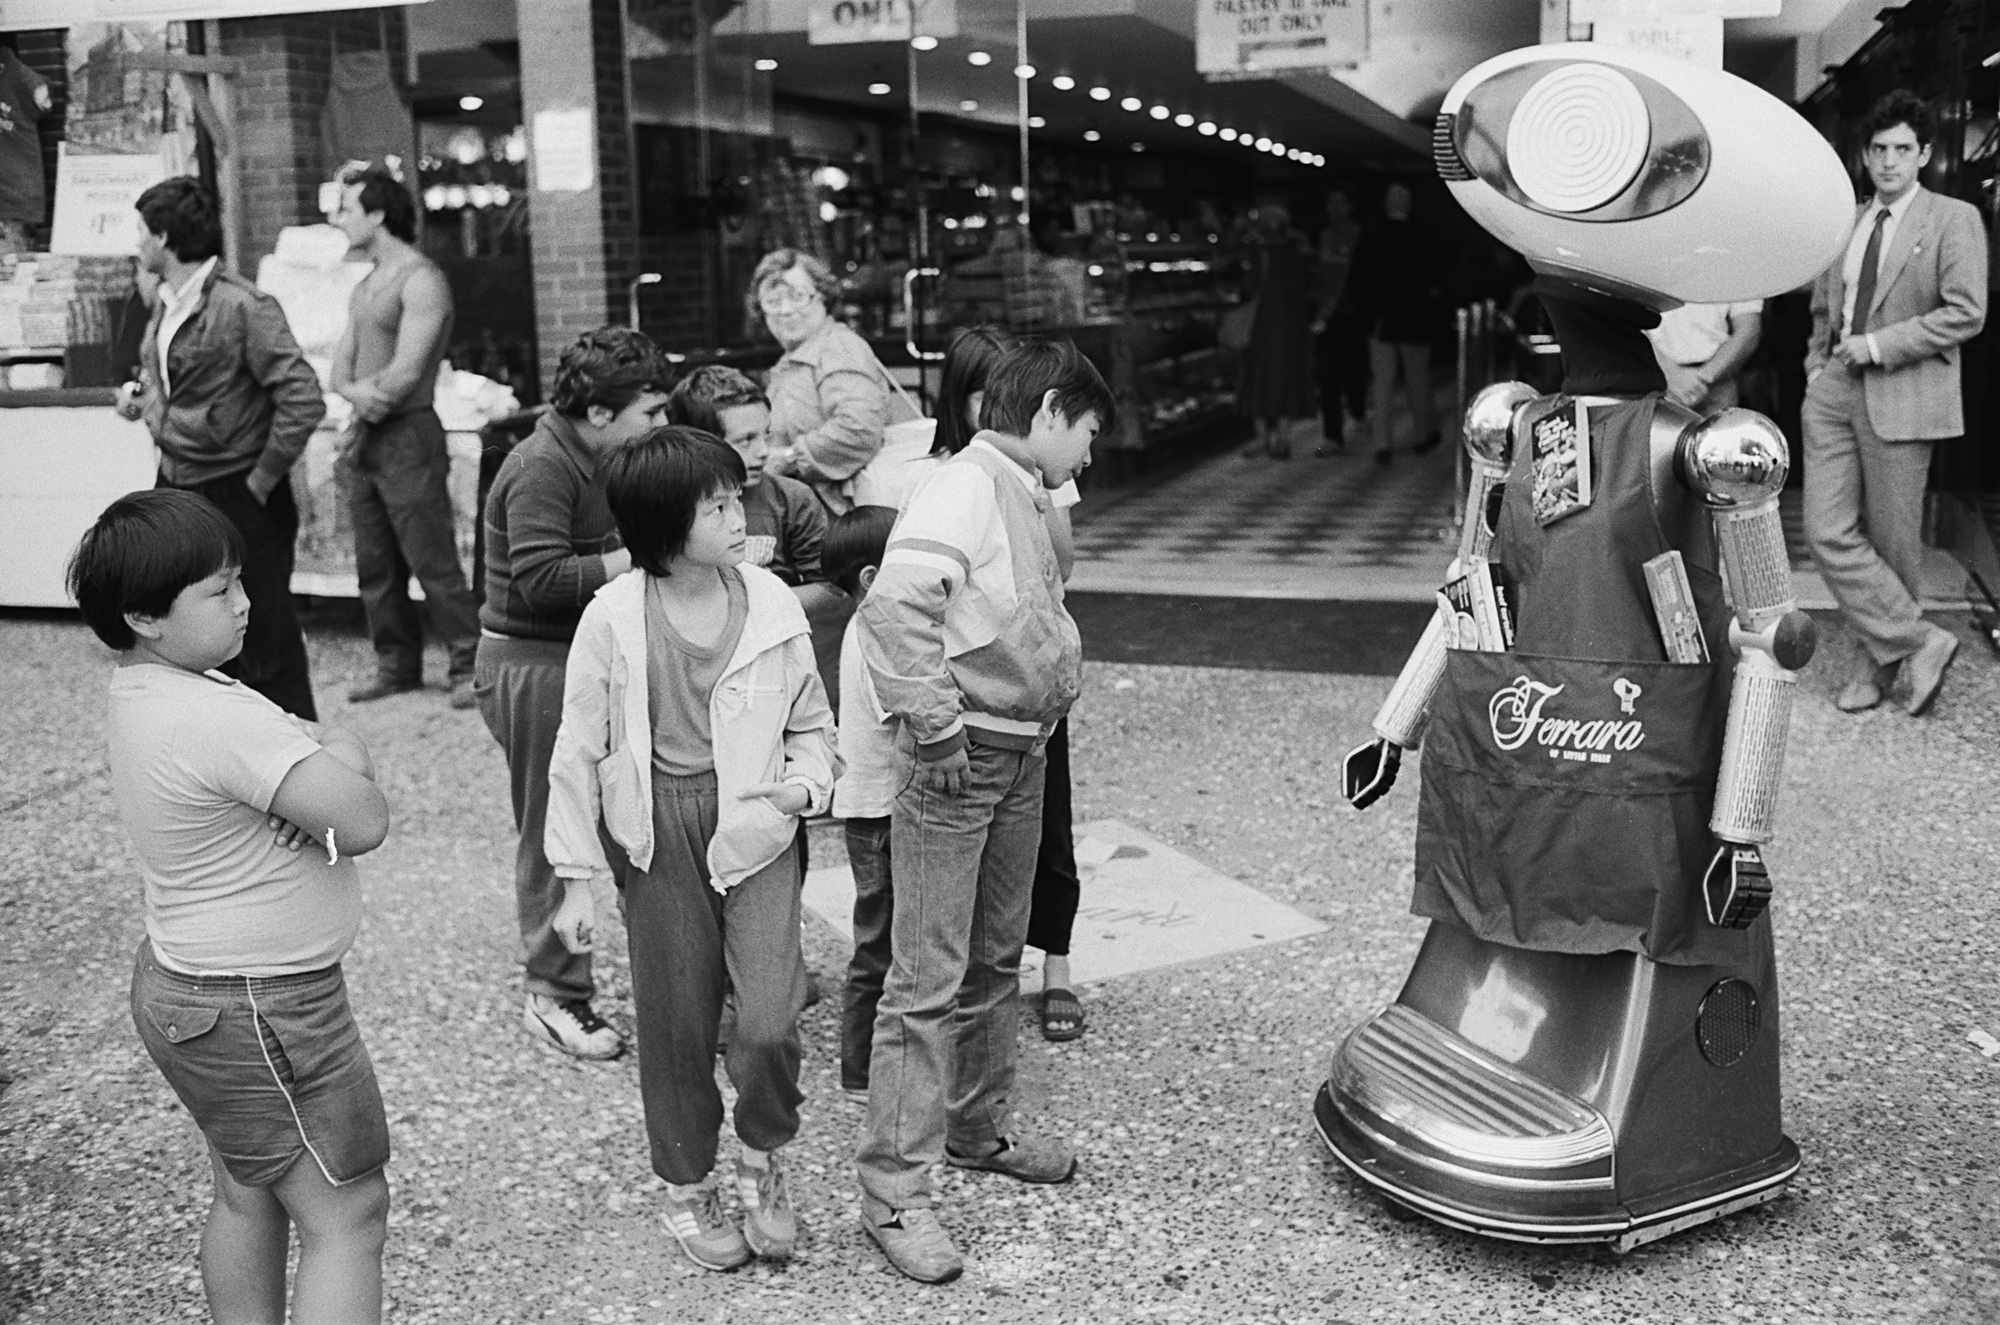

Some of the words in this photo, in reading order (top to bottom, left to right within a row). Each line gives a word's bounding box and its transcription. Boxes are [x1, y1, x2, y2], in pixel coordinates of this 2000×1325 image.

[833, 0, 927, 25] ONLY
[1238, 16, 1270, 35] OUT
[1280, 12, 1325, 31] ONLY
[1489, 675, 1645, 750] Ferrara
